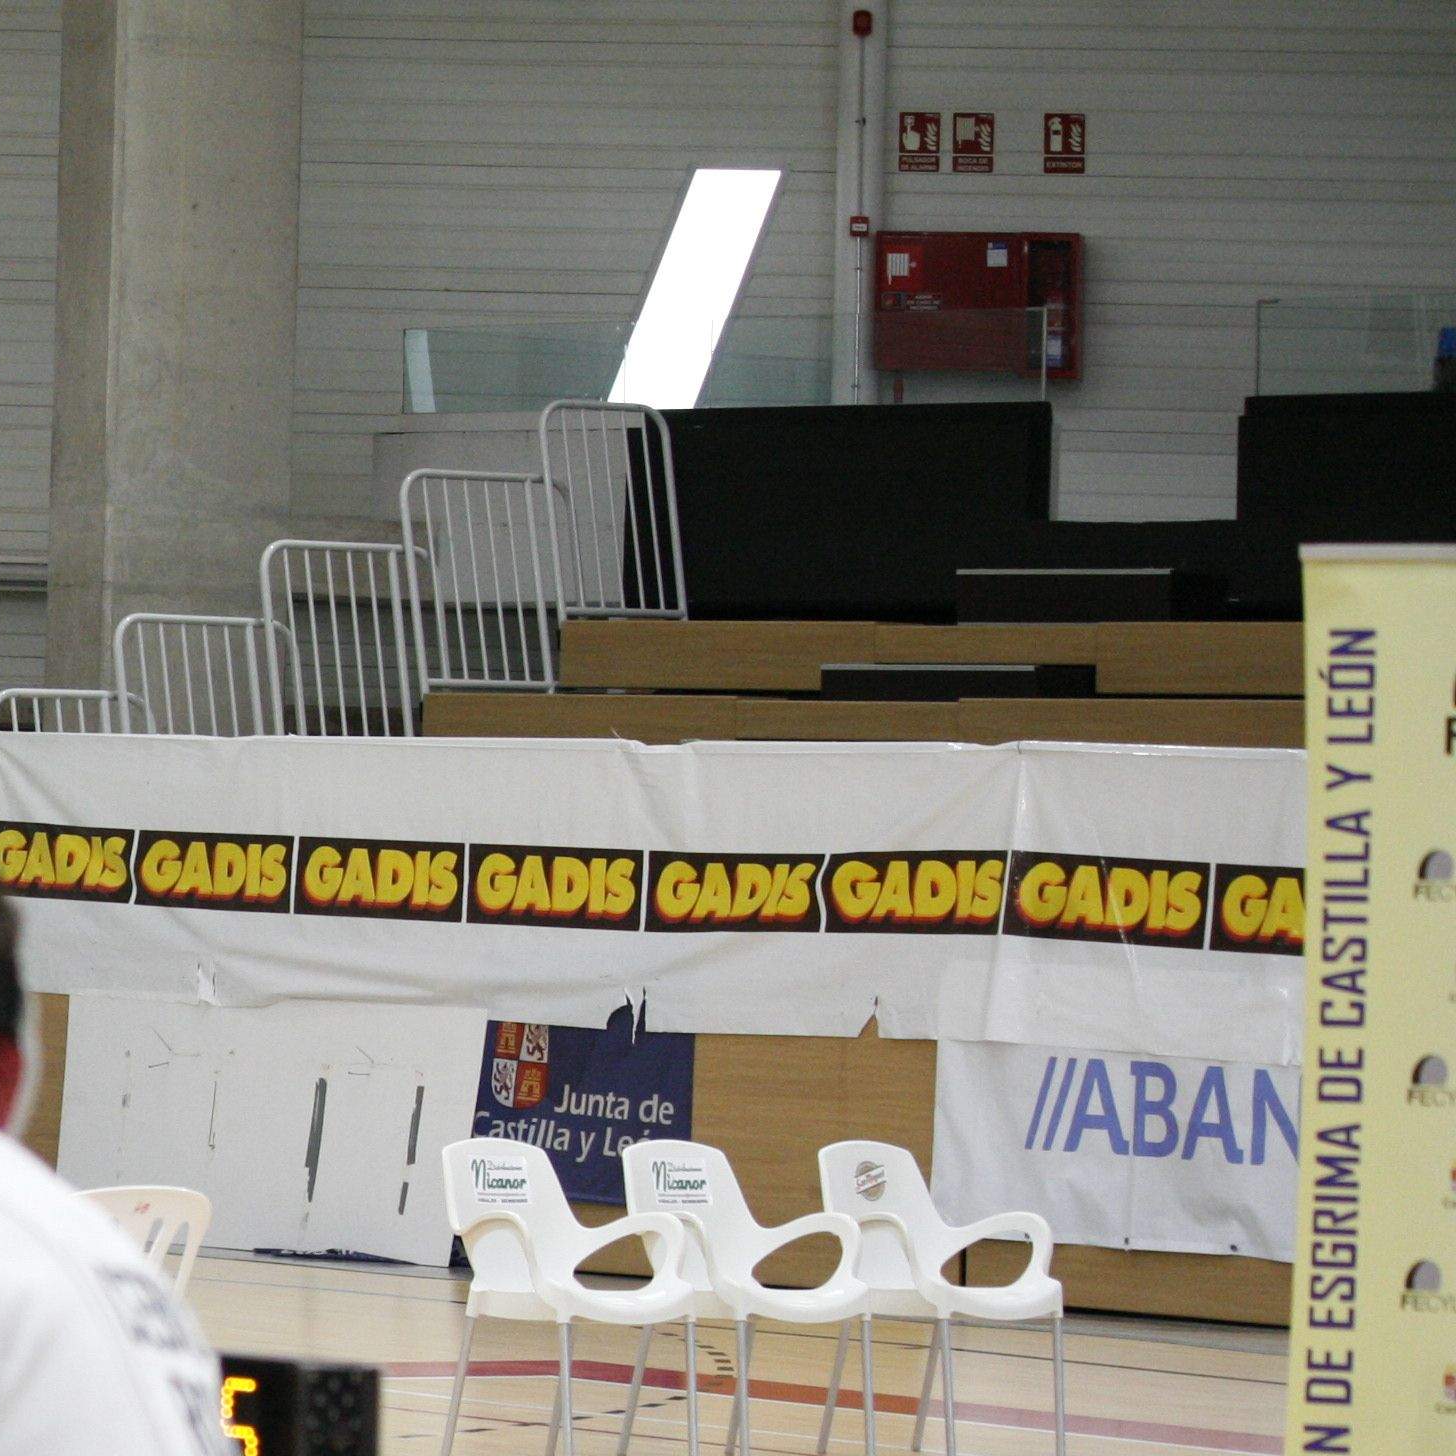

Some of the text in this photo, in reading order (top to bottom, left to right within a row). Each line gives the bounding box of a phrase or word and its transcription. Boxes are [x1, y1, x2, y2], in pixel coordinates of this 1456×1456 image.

[1317, 628, 1378, 746] LEÓN
[1325, 762, 1374, 792] Y
[139, 838, 288, 904] GADIS
[303, 845, 459, 912] GADIS
[475, 852, 637, 921] GADIS
[656, 859, 816, 924] GADIS
[830, 858, 1003, 925] GADIS
[1019, 861, 1203, 938] GADIS
[1319, 807, 1372, 1030] CASTILLA
[554, 1083, 676, 1126] Junta de
[1315, 1046, 1366, 1105] DE
[473, 1110, 572, 1152] Castilla
[575, 1130, 596, 1164] y
[1307, 1122, 1362, 1331] ESGRIMA
[1305, 1348, 1355, 1406] DE
